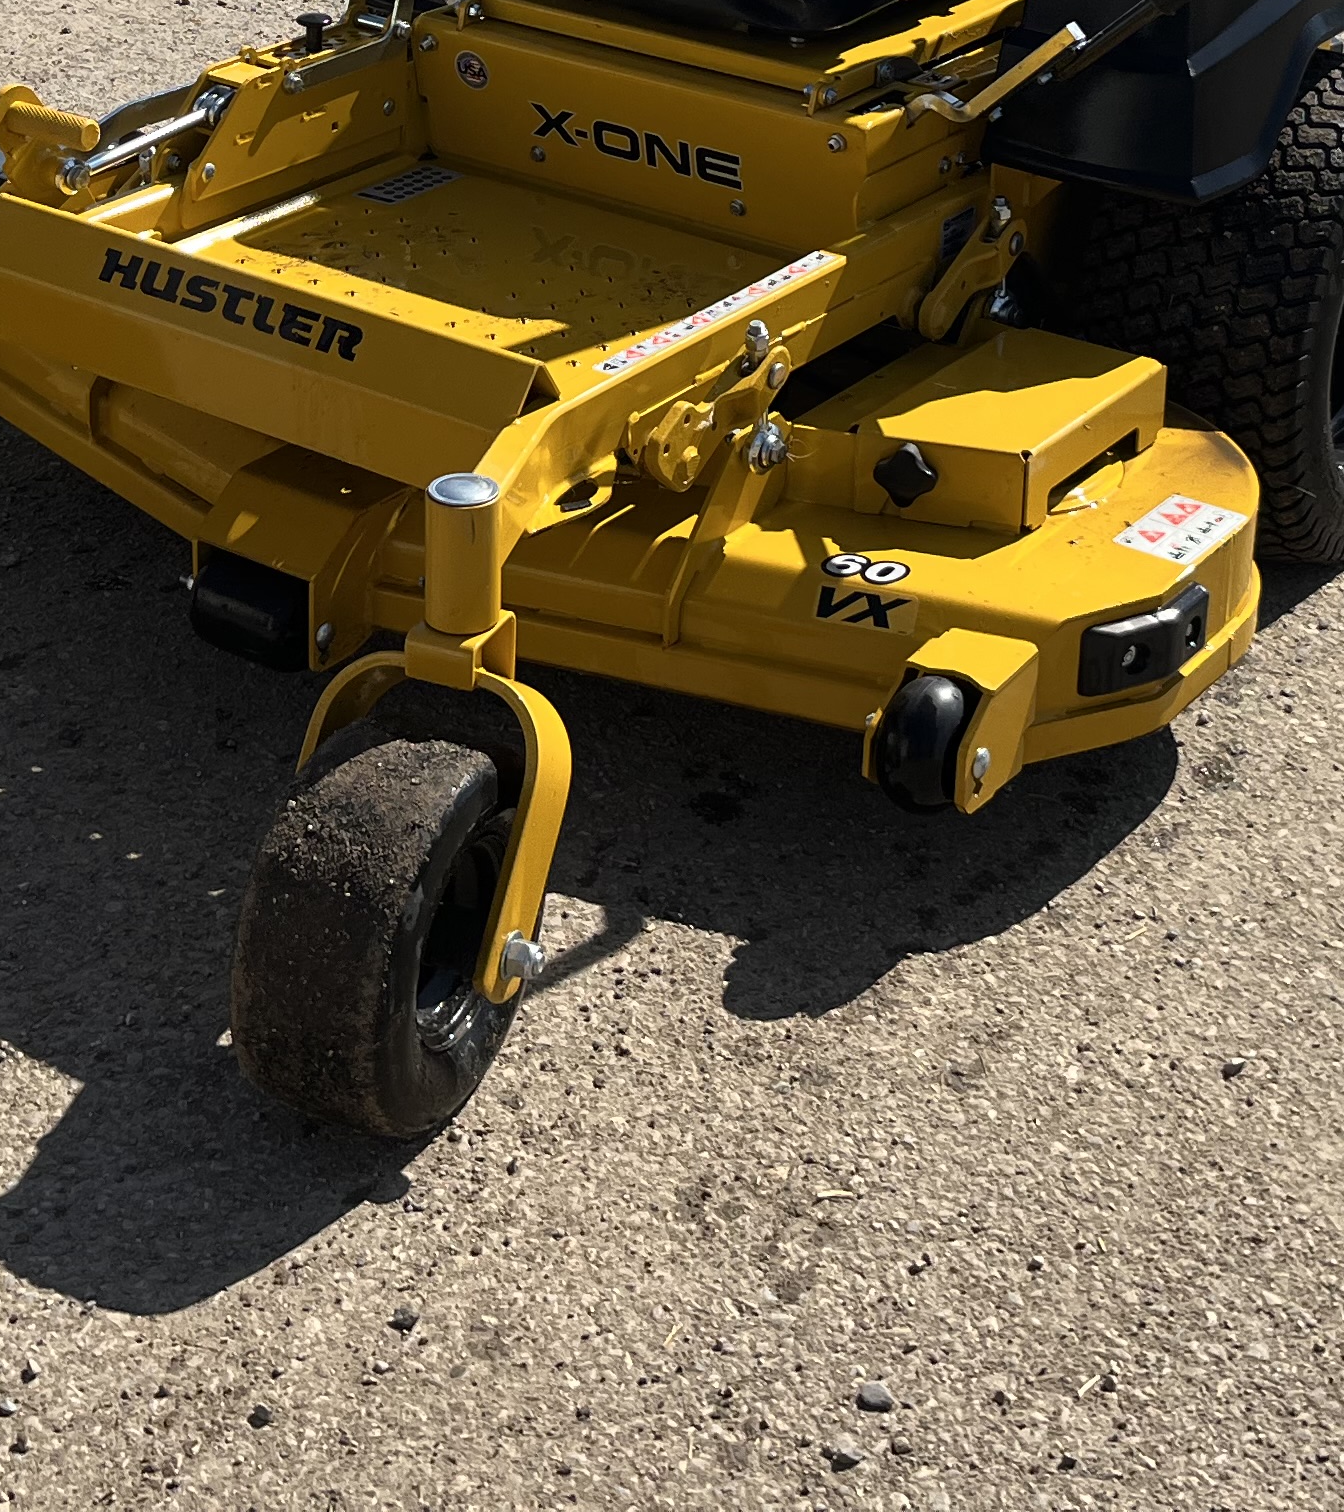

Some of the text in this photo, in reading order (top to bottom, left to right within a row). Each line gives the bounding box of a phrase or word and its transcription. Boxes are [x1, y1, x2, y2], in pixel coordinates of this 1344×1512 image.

[457, 61, 488, 80] USA
[529, 100, 743, 191] X-ONE
[98, 248, 363, 362] HUSTLER
[821, 553, 911, 585] 60
[816, 585, 913, 629] VX
